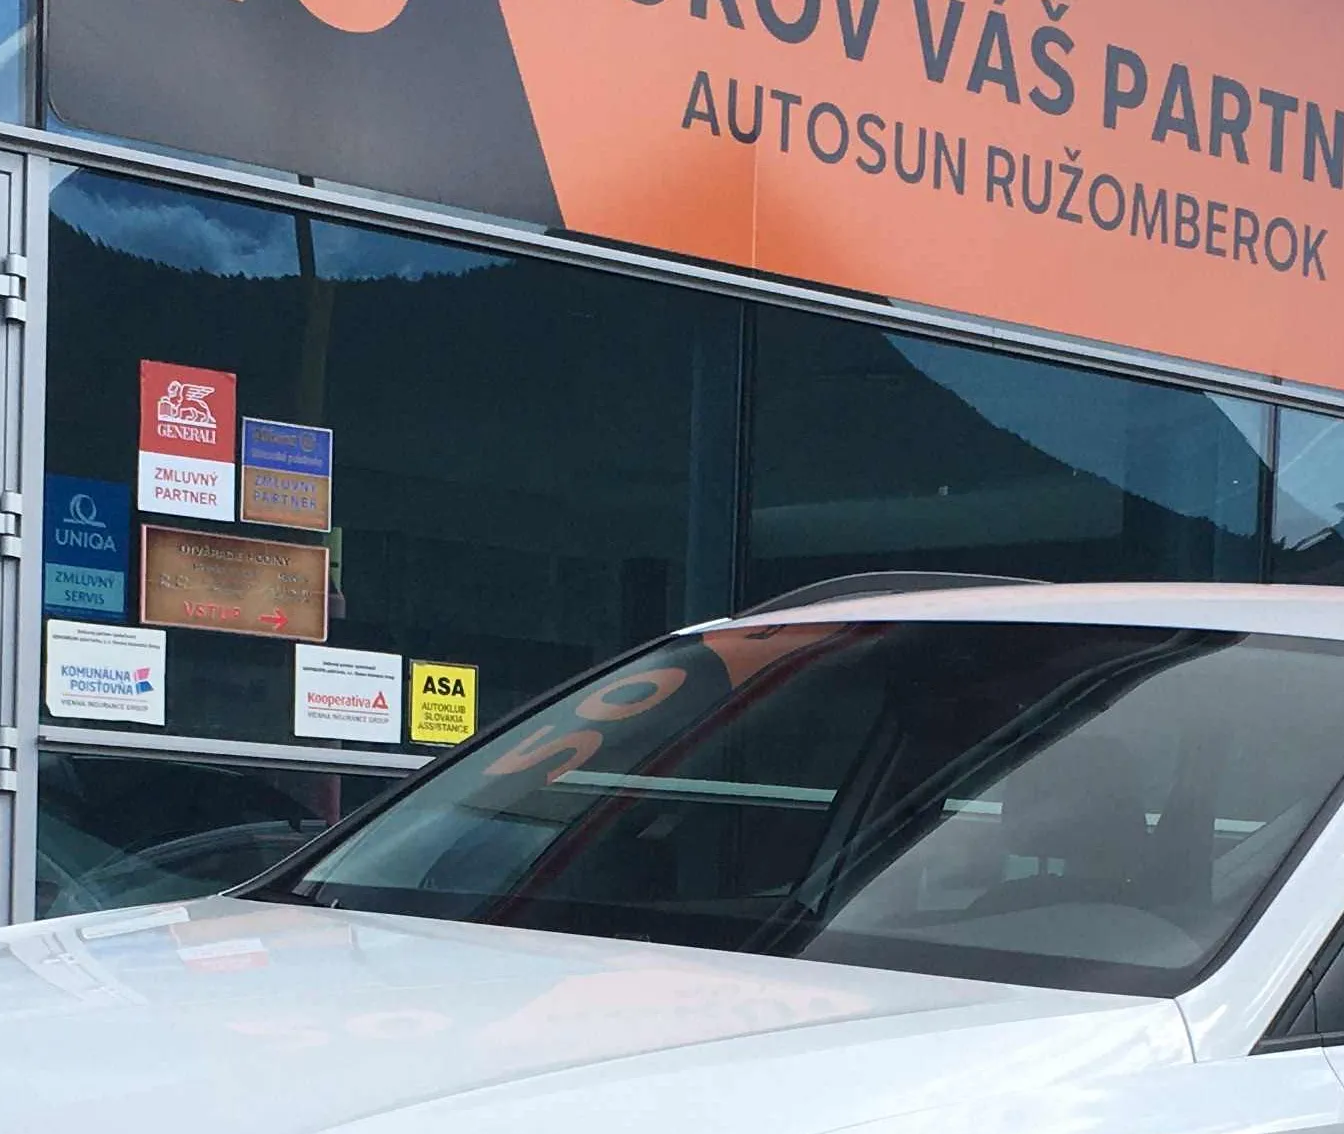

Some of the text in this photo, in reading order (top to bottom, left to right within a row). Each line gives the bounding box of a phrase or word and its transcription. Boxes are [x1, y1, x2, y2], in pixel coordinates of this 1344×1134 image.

[681, 70, 1329, 282] AUTOSUN RUŽOMBEROK
[157, 423, 217, 445] GENERALI
[154, 466, 218, 487] ZMLUVNÝ
[155, 486, 218, 507] PARTNER
[55, 528, 117, 553] UNIQA
[63, 589, 106, 606] SERVIS
[422, 675, 466, 698] ASA
[307, 691, 371, 709] Kooperativa
[421, 701, 467, 714] AUTOKLUB
[417, 721, 469, 734] ASSISTANCE
